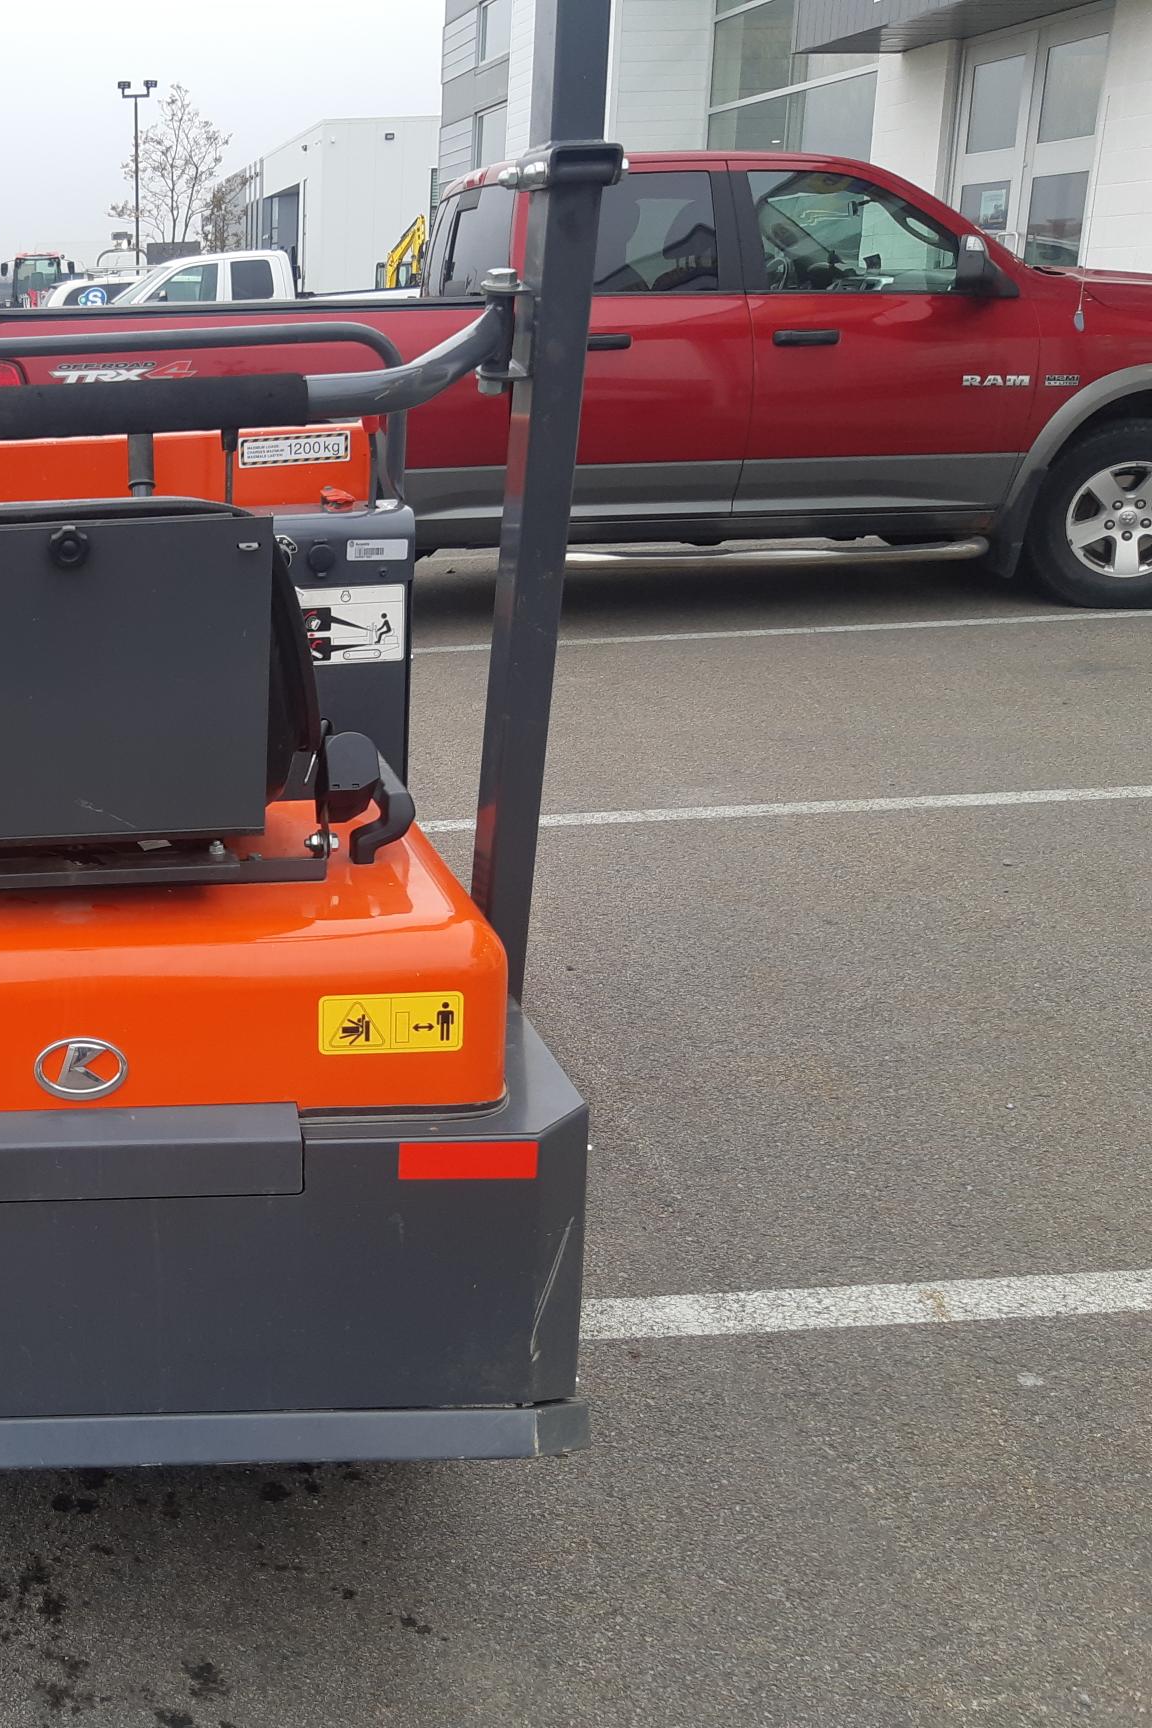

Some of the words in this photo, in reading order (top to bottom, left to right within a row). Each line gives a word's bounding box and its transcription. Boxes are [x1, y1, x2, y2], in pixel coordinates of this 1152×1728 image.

[962, 375, 1031, 386] RAM
[288, 441, 321, 456] 1200
[323, 441, 340, 456] kg
